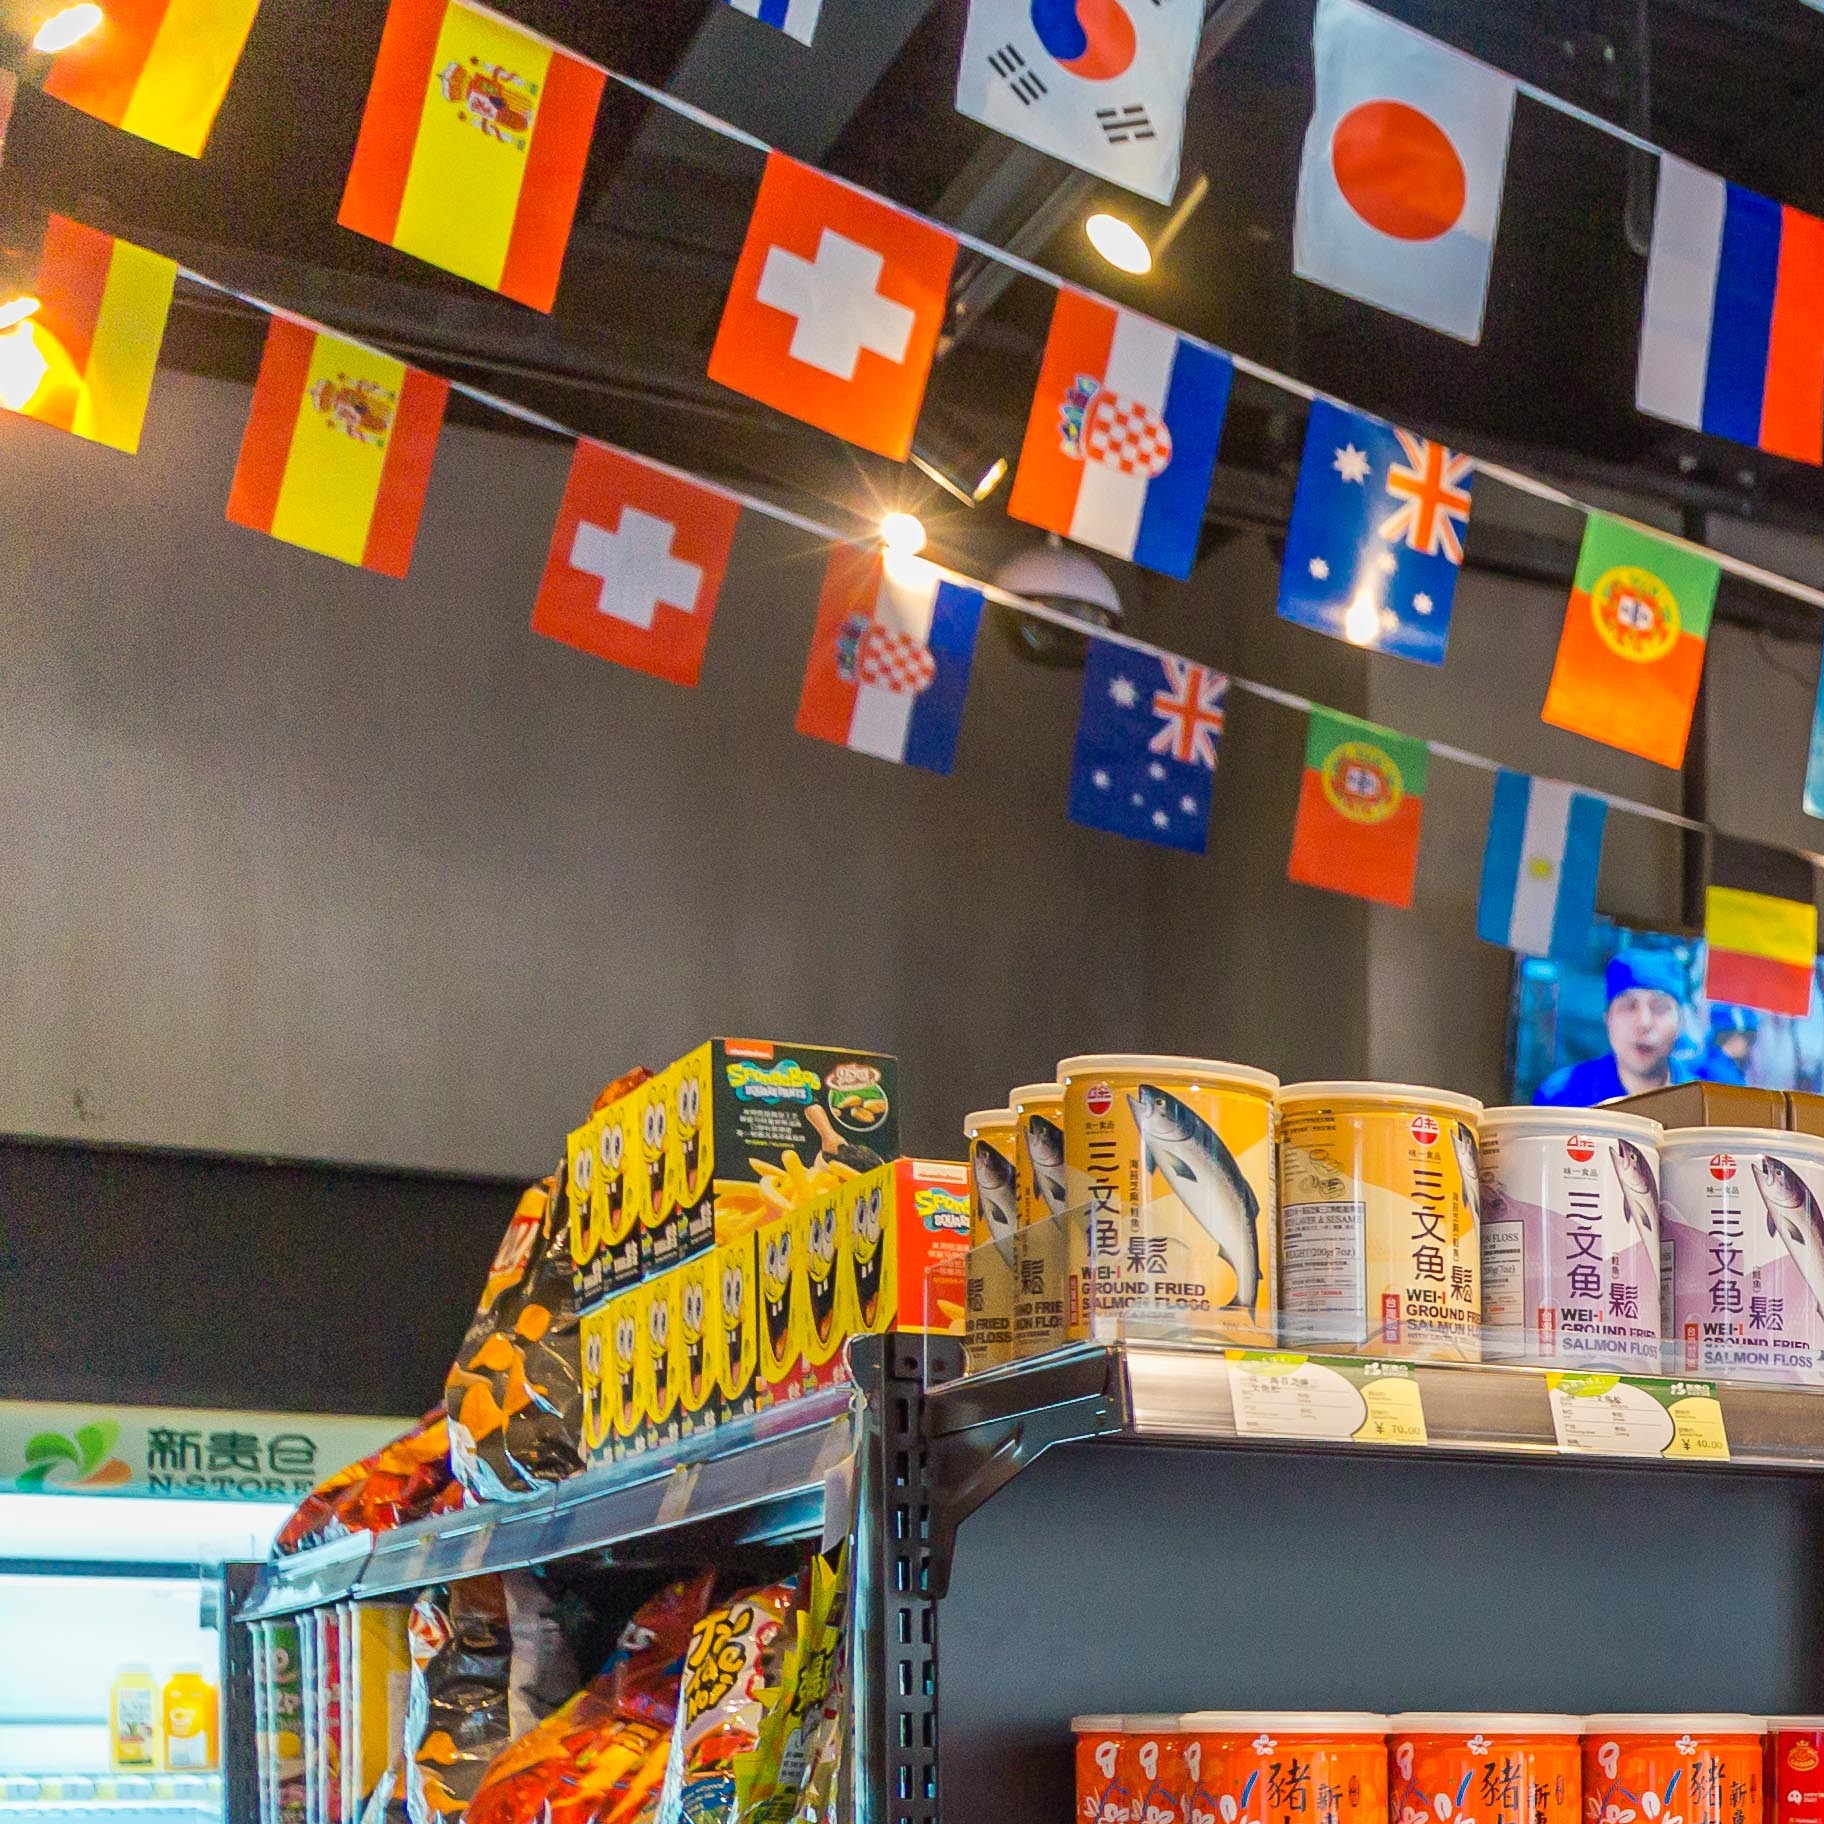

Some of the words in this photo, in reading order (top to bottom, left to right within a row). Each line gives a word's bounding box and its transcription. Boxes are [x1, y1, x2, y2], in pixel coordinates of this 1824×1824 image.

[1411, 1169, 1445, 1281] 三文魚
[1566, 1191, 1603, 1299] 三文魚
[1708, 1210, 1744, 1314] 三文魚
[1081, 1282, 1149, 1296] GROUND
[1154, 1282, 1206, 1297] FRIED
[1609, 1284, 1638, 1320] 鬆
[1406, 1305, 1464, 1322] GROUND
[1749, 1297, 1783, 1331] 鬆
[1562, 1338, 1628, 1353] SALMON
[1704, 1350, 1770, 1366] SALMON
[1773, 1354, 1813, 1368] FLOSS
[148, 1426, 317, 1474] 新贵仓
[1696, 1440, 1722, 1449] 40.00
